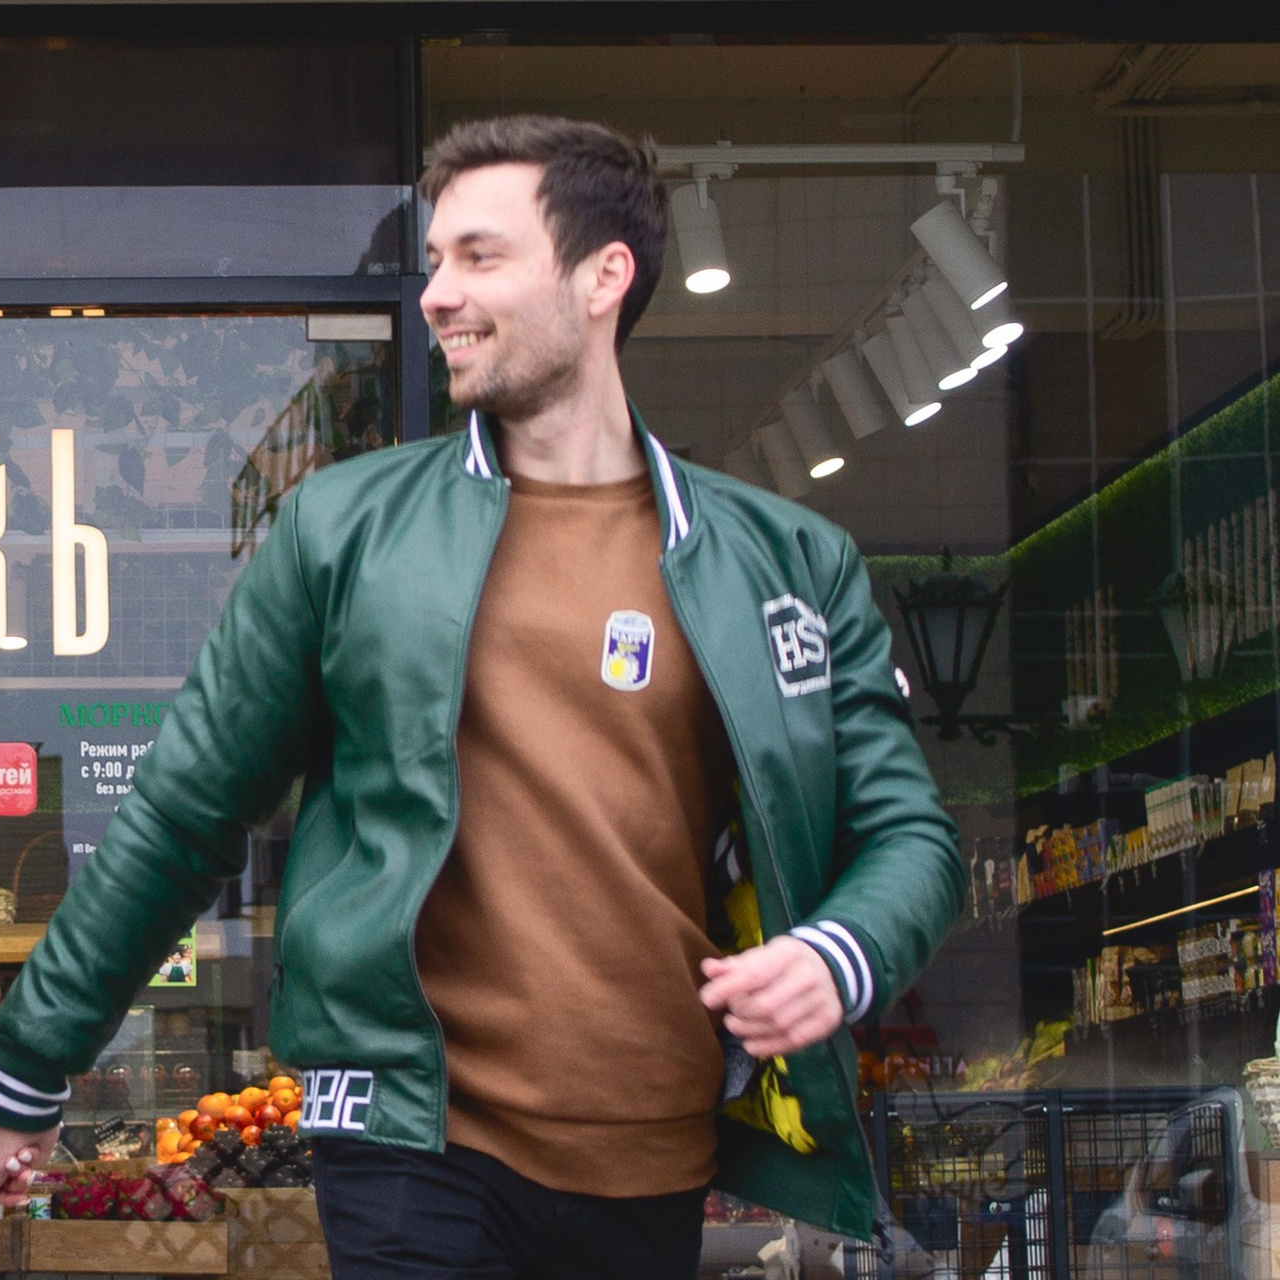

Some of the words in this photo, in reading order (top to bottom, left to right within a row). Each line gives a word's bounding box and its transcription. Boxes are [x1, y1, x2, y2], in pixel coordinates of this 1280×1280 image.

[81, 741, 128, 758] Режим
[93, 761, 122, 778] 9:00
[96, 782, 114, 794] без
